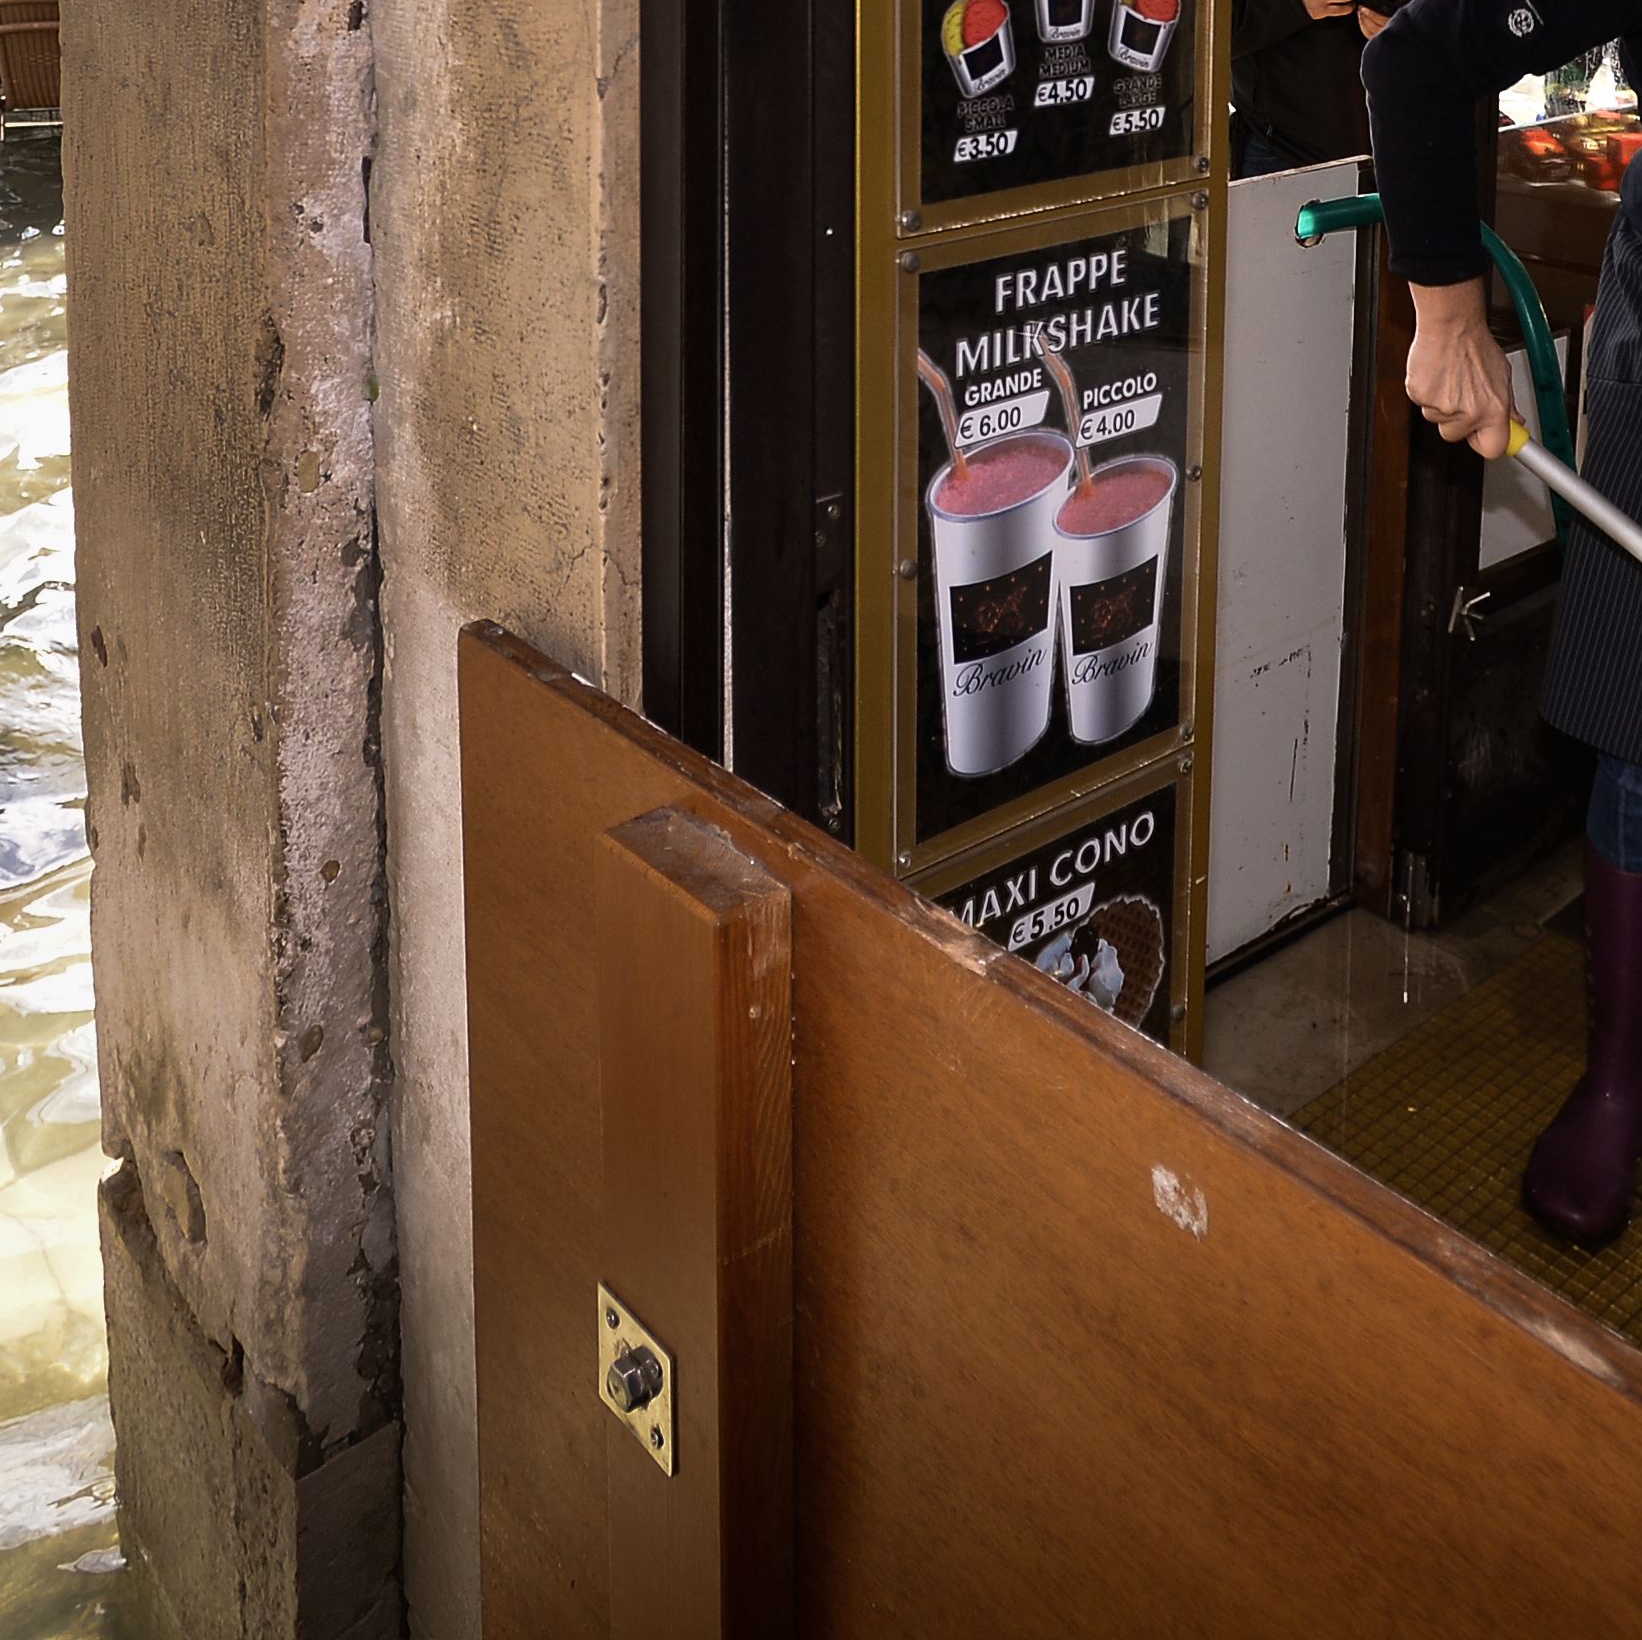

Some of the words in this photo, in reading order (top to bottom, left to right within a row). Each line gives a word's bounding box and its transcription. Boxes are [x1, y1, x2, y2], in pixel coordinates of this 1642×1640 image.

[1045, 44, 1086, 60] MEDIA
[1040, 61, 1090, 79] MEDIUM
[1114, 74, 1163, 93] GRANDE
[957, 96, 1014, 118] PICCOLA
[1119, 92, 1157, 109] LARGE
[965, 116, 1006, 133] SMALL
[996, 249, 1127, 314] FRAPPE
[957, 292, 1160, 378] MILKSHAKE
[964, 368, 1043, 406] GRANDE
[1083, 372, 1158, 410] PICCOLO
[979, 407, 1022, 437] 6.00
[1096, 409, 1136, 437] 4.00
[952, 647, 1048, 698] Bravin
[1071, 640, 1153, 686] Bravin
[948, 867, 1039, 928] MAXI
[1050, 810, 1155, 887] CONO
[1029, 896, 1080, 940] 5.50
